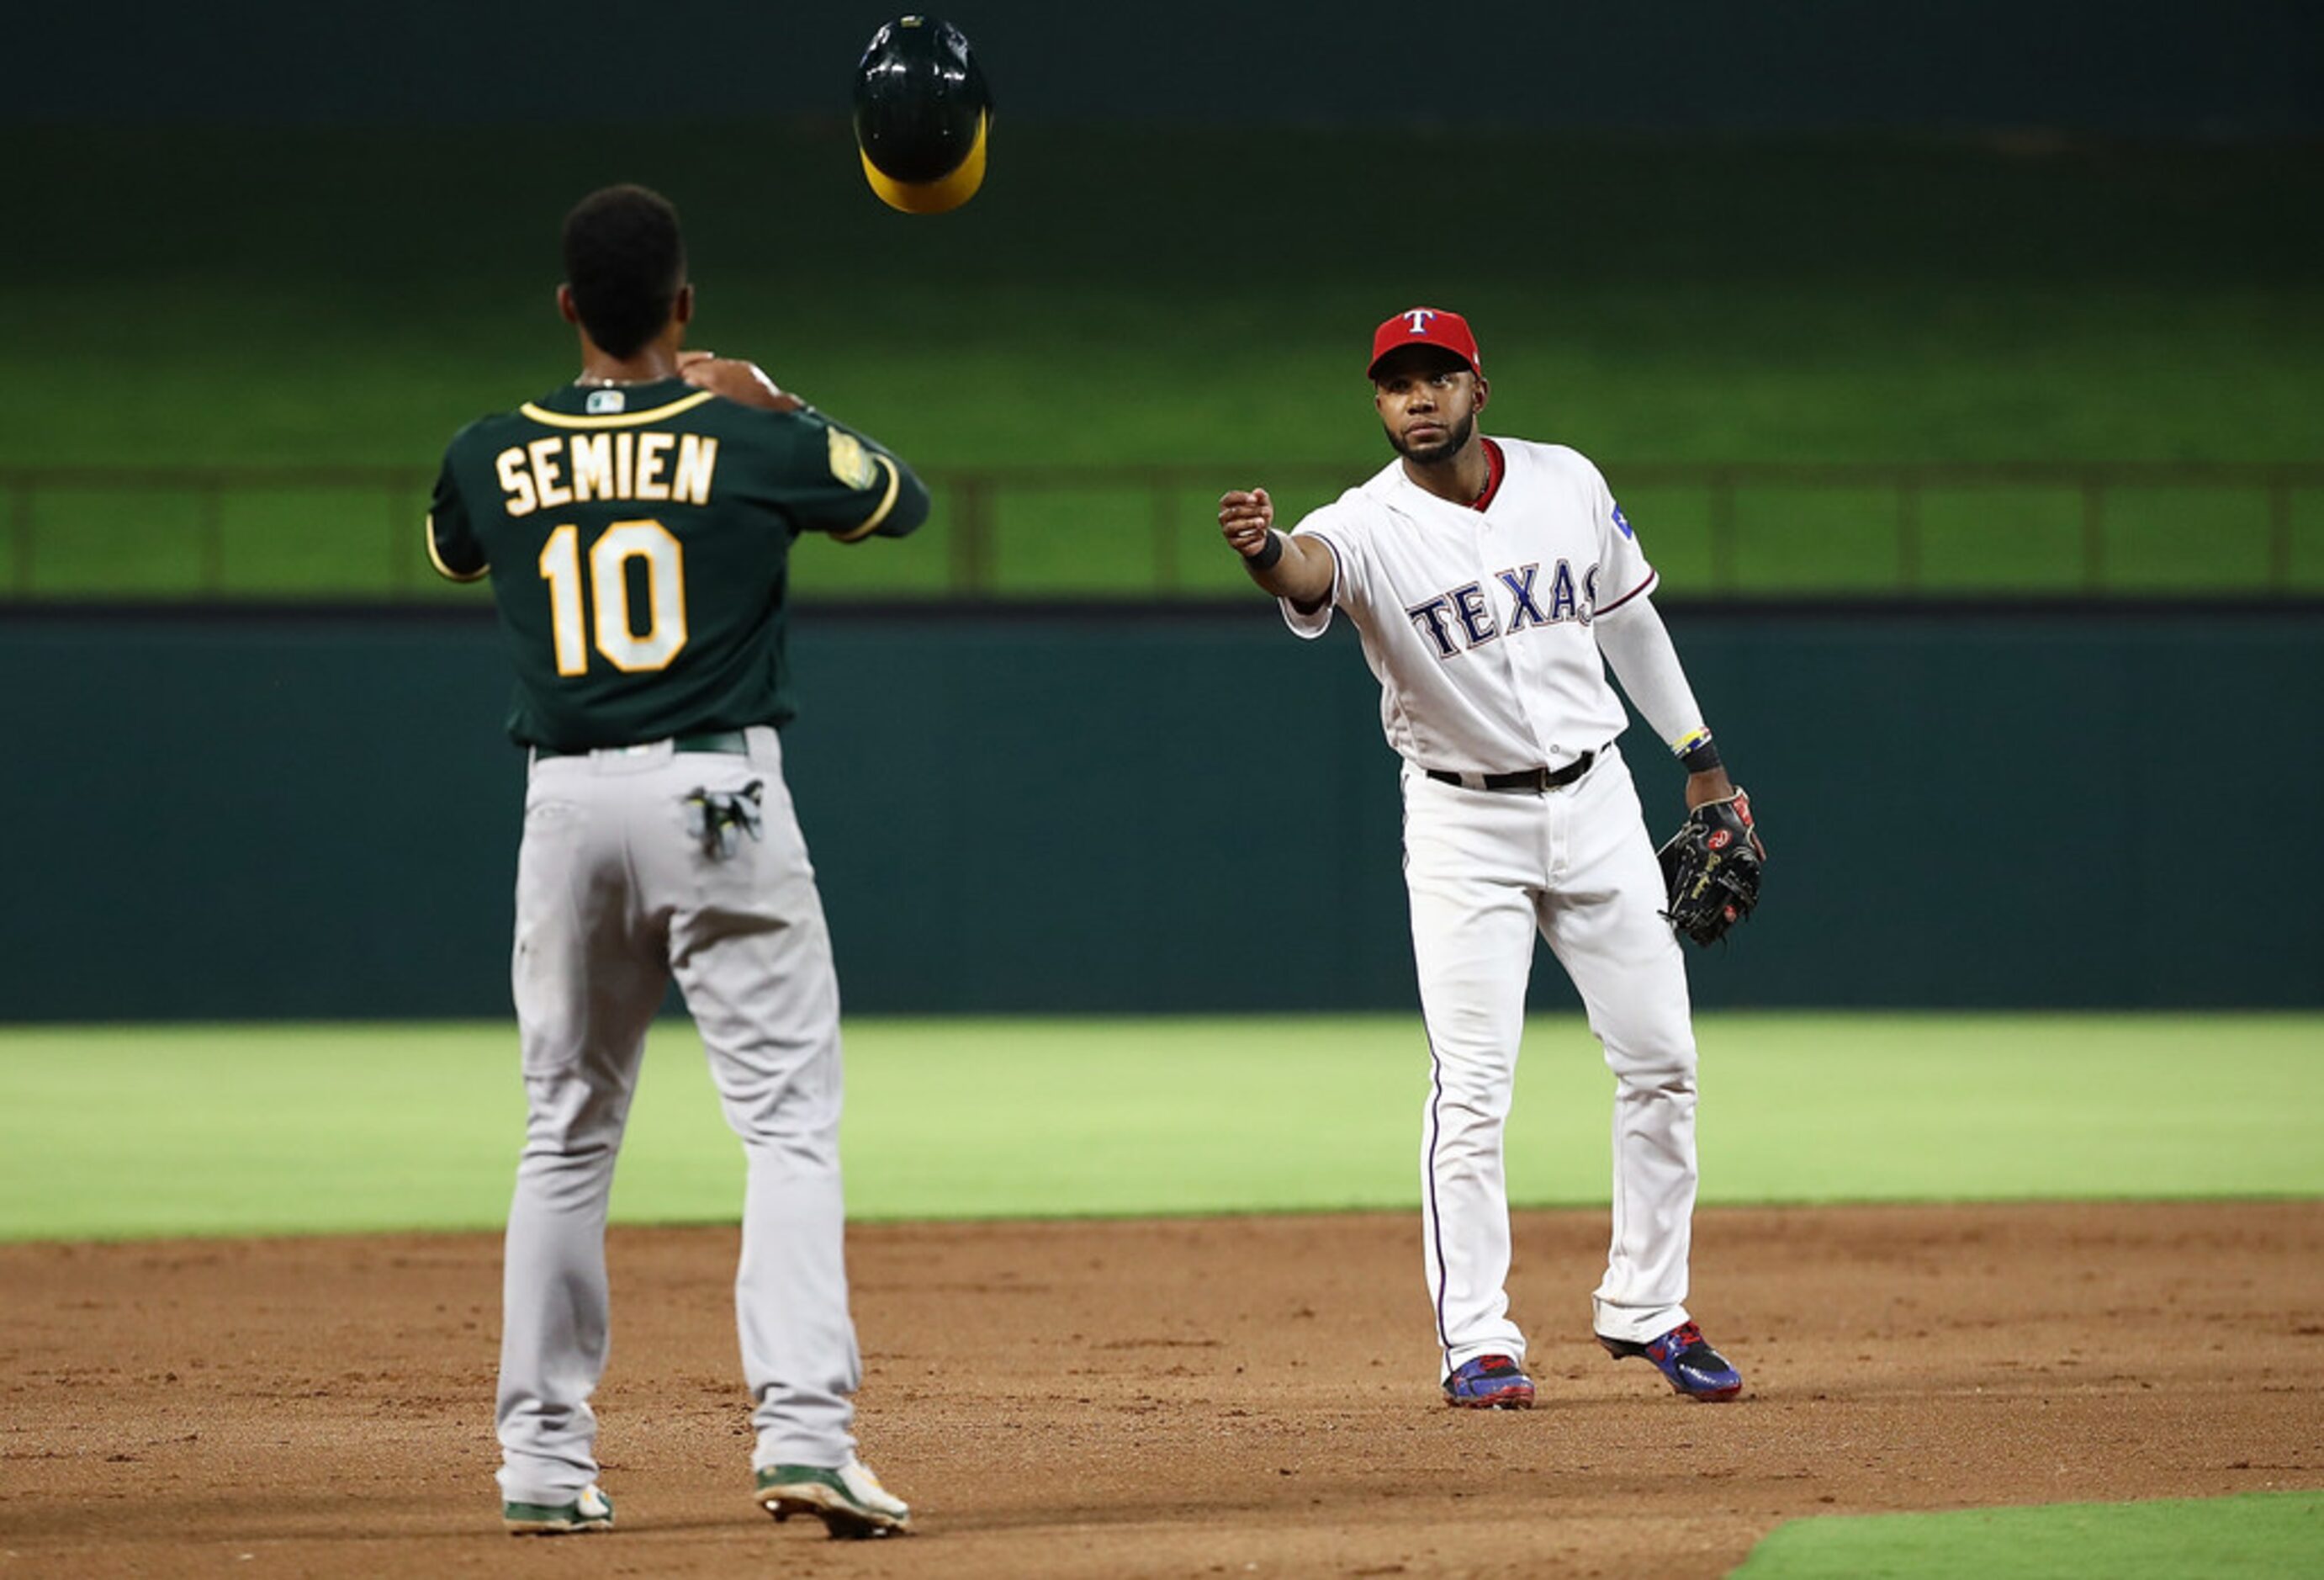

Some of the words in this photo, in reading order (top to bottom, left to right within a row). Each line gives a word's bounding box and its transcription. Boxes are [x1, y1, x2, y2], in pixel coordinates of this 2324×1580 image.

[1404, 310, 1436, 334] T
[495, 432, 718, 517] SEMIEN
[539, 519, 688, 676] 10
